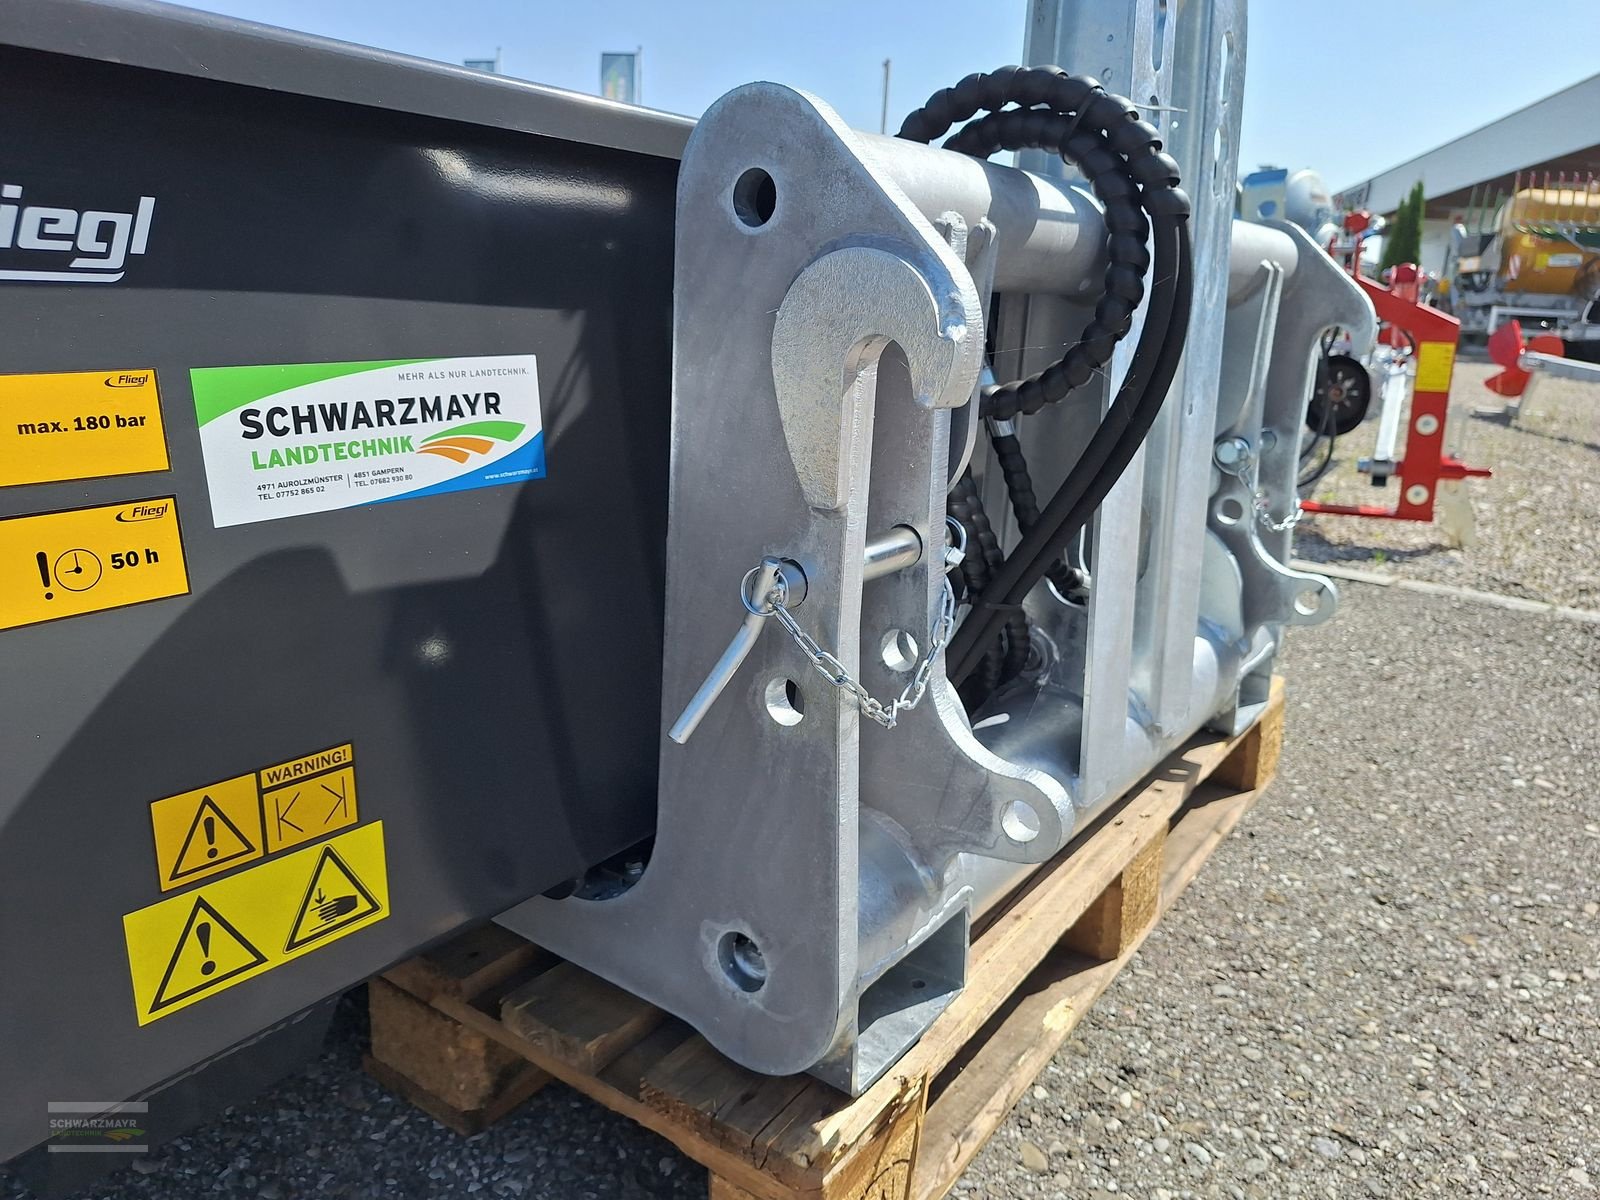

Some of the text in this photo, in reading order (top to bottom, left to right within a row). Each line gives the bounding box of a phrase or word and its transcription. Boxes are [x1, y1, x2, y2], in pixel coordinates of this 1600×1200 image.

[118, 374, 149, 386] Fliegl
[398, 368, 529, 381] MEHR ALS NUR LANDTECHNIK.
[17, 413, 146, 435] max. 180 bar
[239, 392, 502, 440] SCHWARZMAYR
[251, 435, 416, 471] LANDTECHNIK
[354, 467, 405, 479] 4851 GAMPERN
[256, 474, 343, 491] 4971 AUROLZMÜNSTER
[258, 493, 274, 501] TEL.
[276, 489, 299, 499] 07752
[301, 487, 315, 495] 865
[132, 502, 169, 518] Fliegl
[111, 548, 159, 570] 50 h
[266, 748, 347, 784] WARNING!
